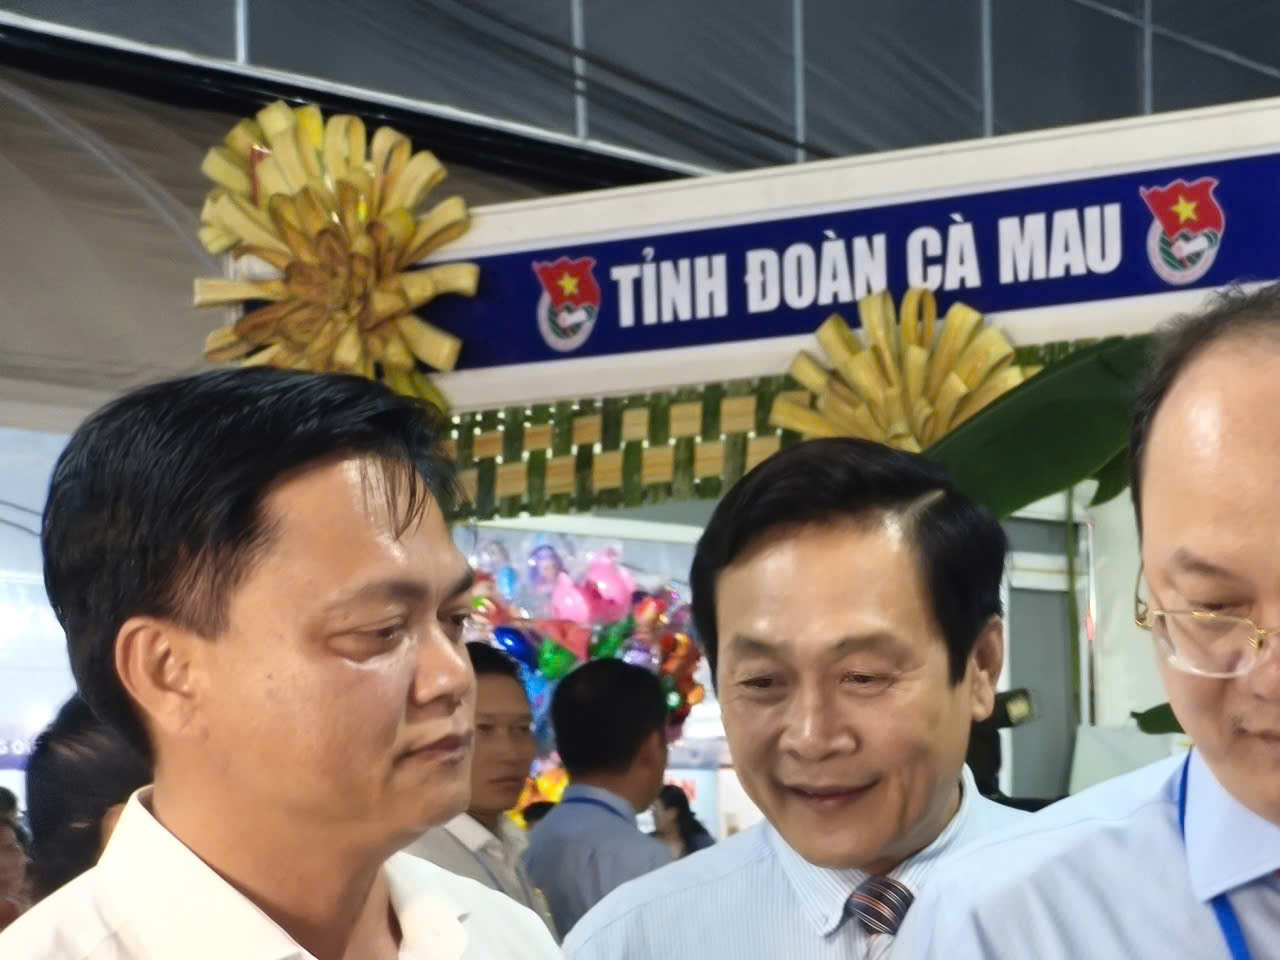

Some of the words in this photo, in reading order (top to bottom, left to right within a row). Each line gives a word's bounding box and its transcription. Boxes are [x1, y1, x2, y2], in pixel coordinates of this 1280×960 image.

[610, 246, 728, 328] TỈNH
[744, 230, 887, 314] ĐOÀN
[906, 213, 981, 292] CÀ
[998, 203, 1123, 284] MAU
